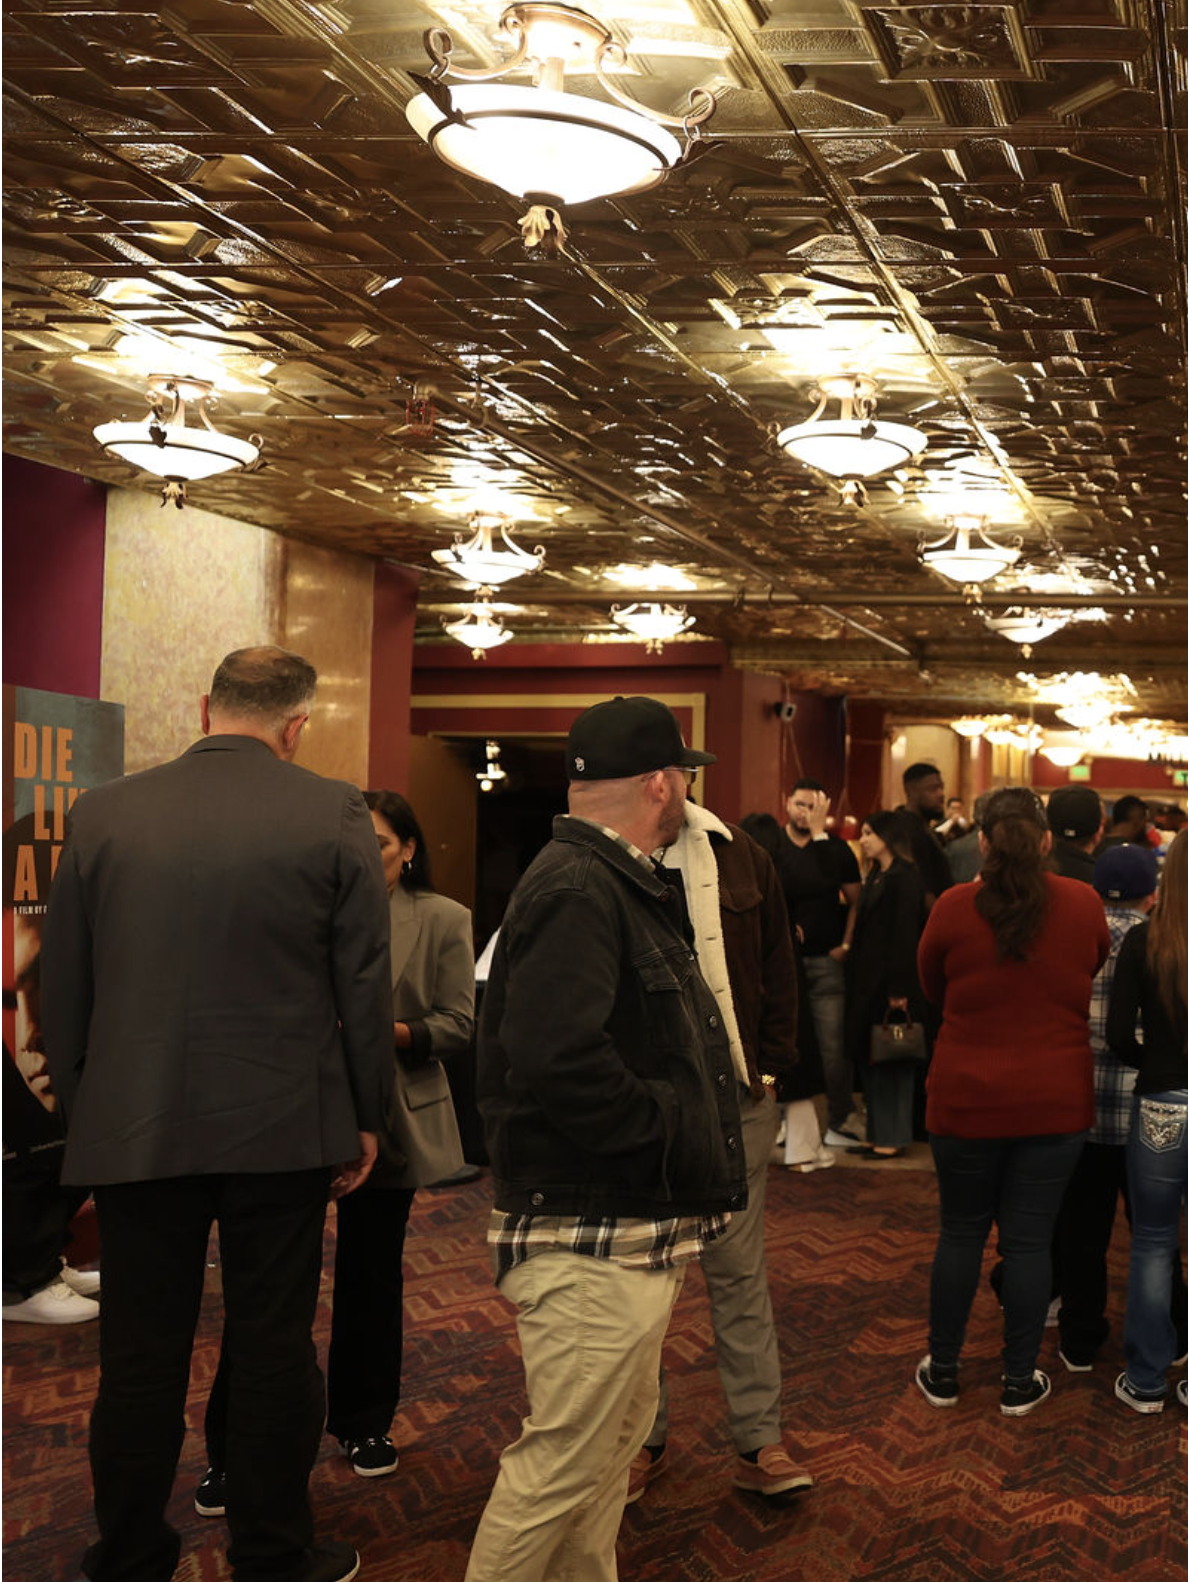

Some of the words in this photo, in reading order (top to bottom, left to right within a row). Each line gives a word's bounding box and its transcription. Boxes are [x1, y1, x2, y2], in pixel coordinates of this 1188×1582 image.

[14, 721, 74, 783] DIE
[34, 784, 90, 841] LI
[13, 845, 38, 901] A
